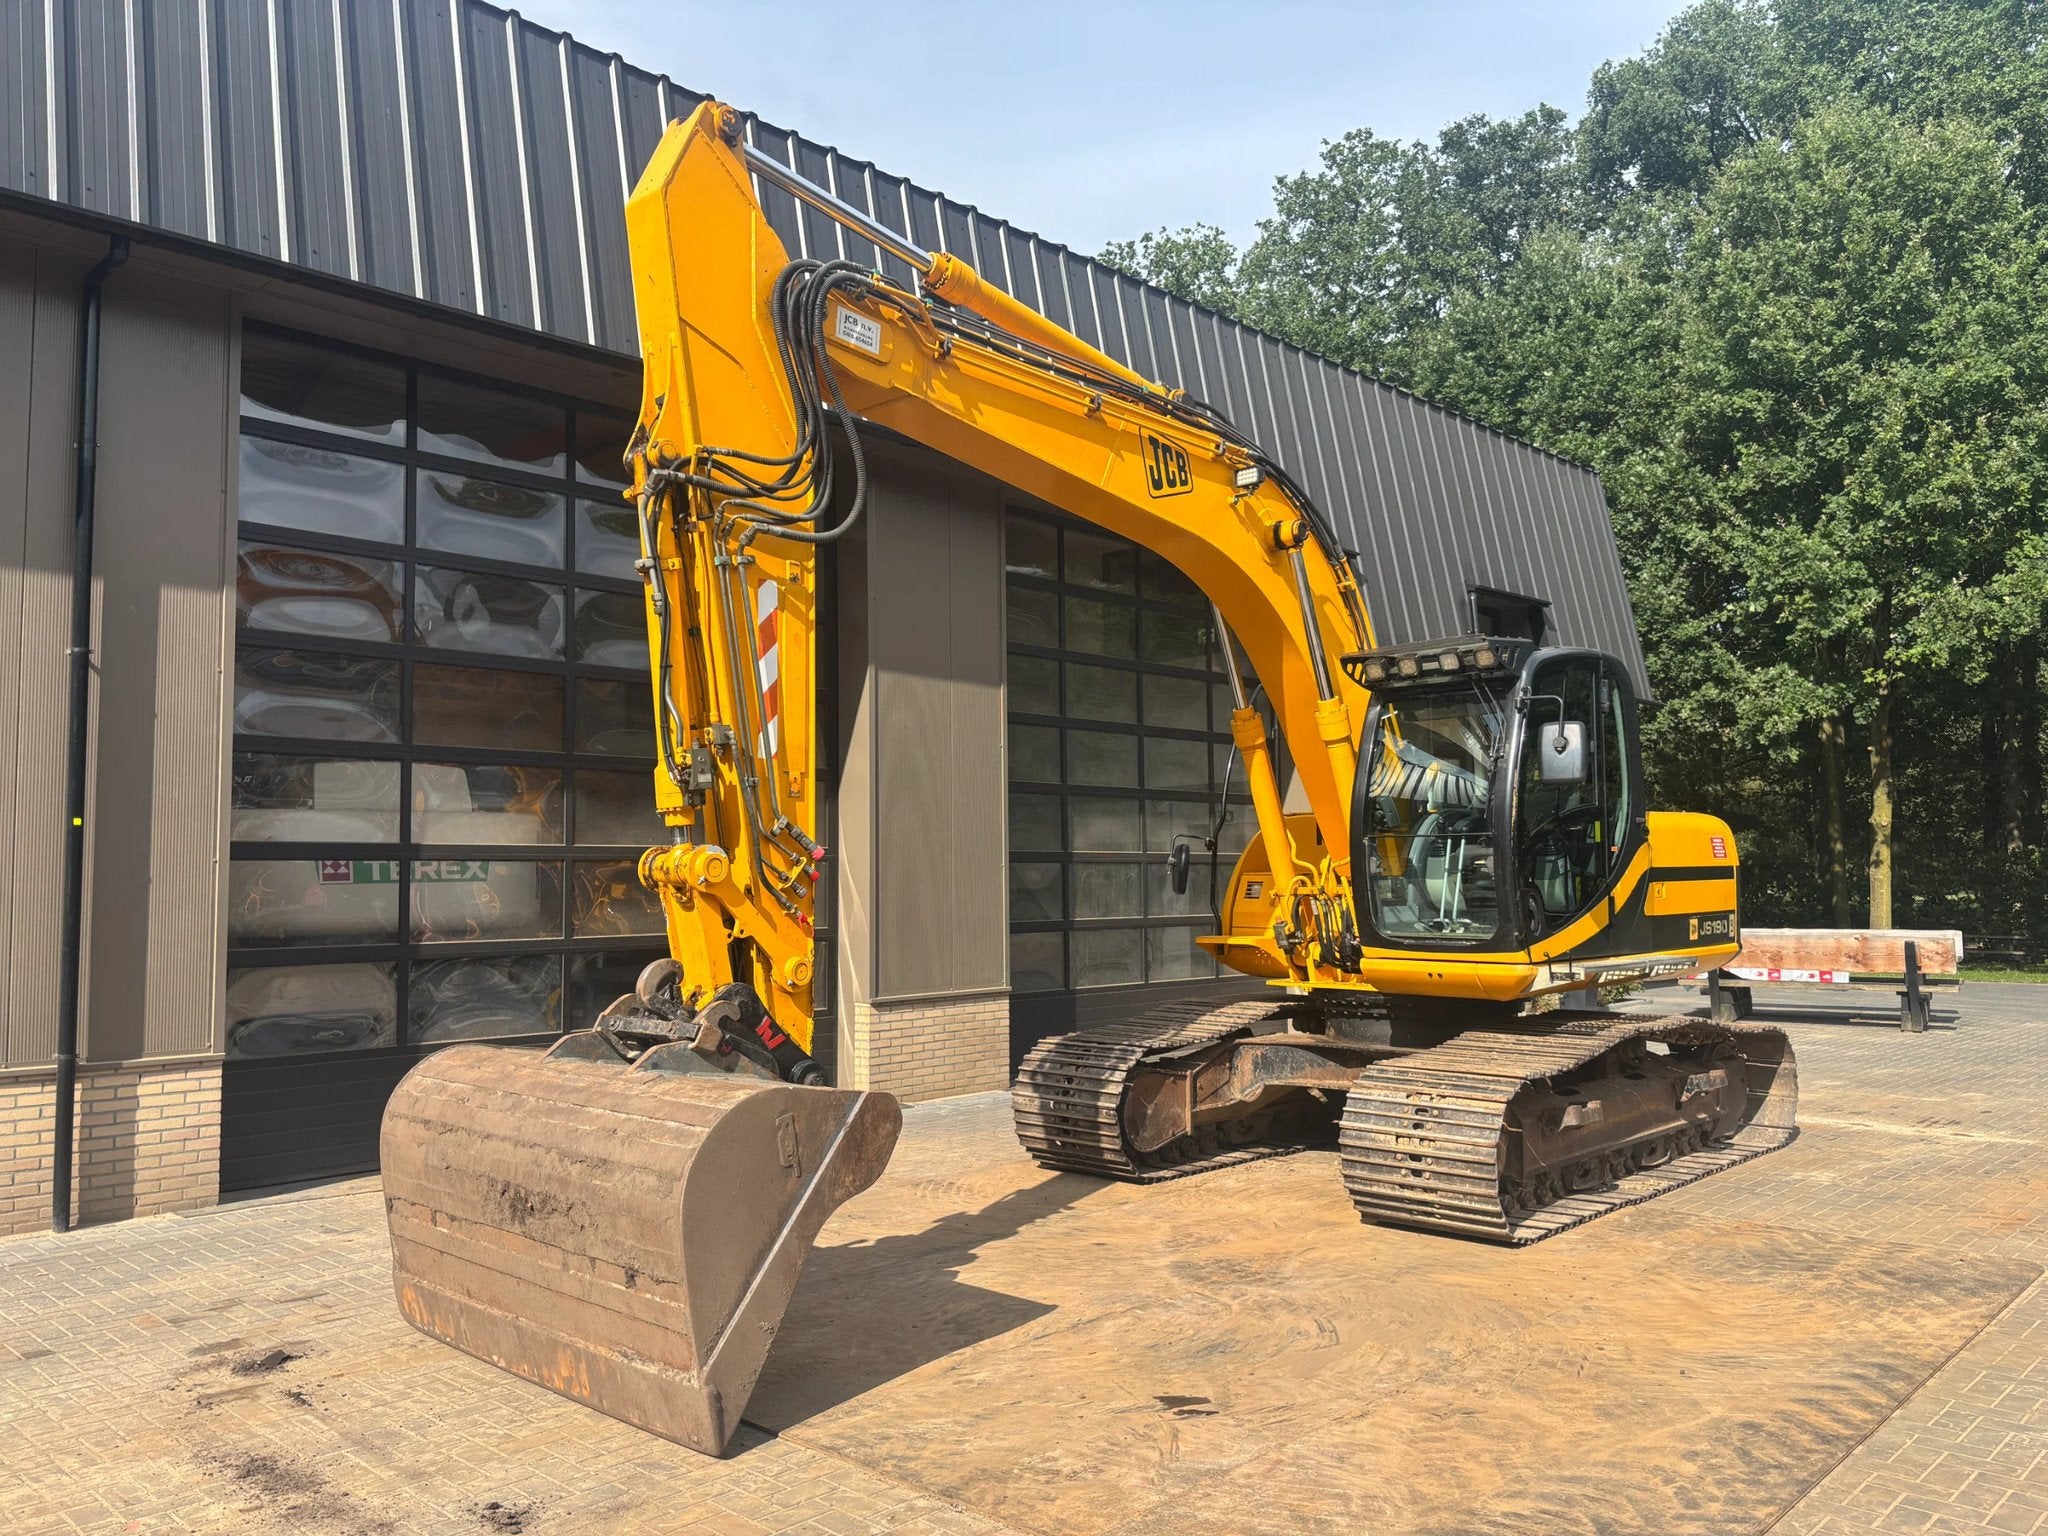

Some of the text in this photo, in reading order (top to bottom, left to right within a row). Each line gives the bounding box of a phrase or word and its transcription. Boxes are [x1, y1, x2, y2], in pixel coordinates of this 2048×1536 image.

[843, 314, 858, 326] JCB
[1148, 434, 1189, 491] JCB
[1700, 919, 1728, 936] JS190
